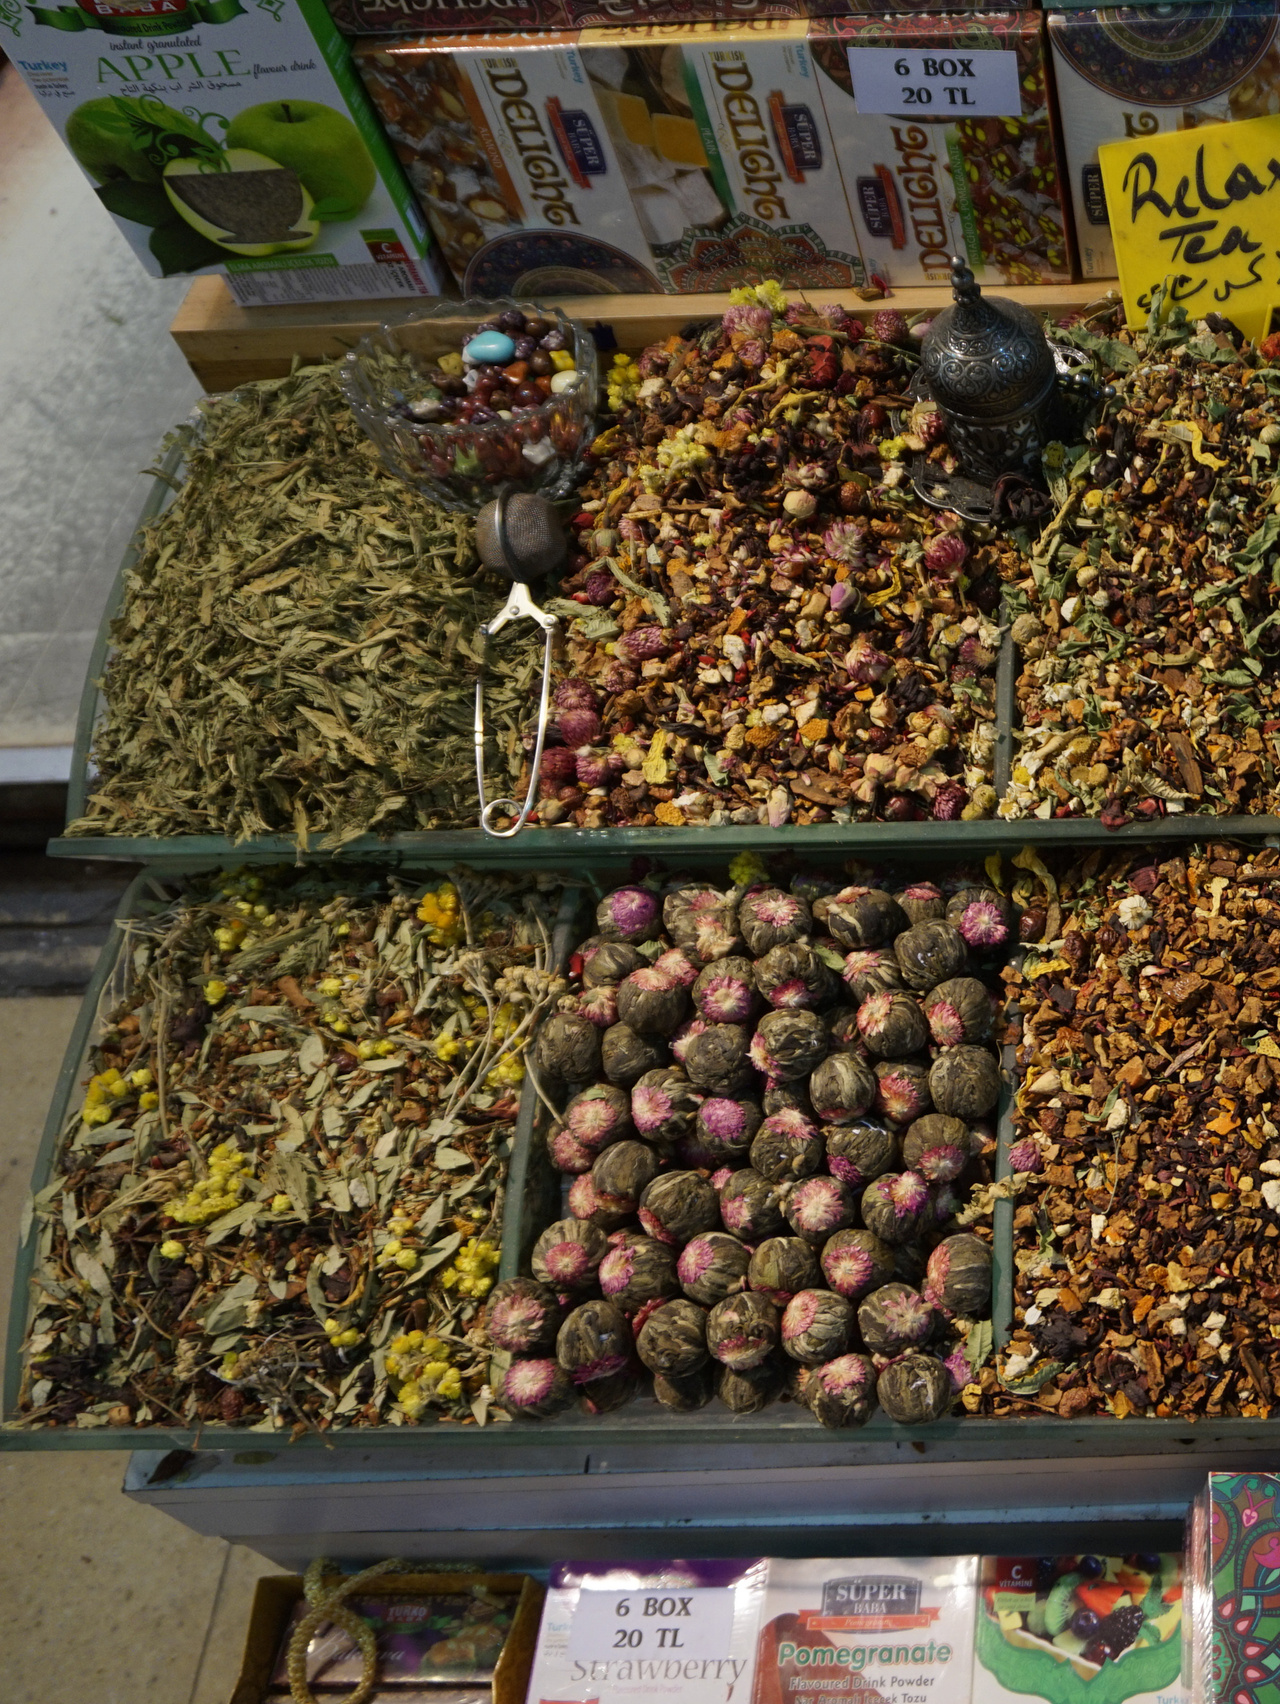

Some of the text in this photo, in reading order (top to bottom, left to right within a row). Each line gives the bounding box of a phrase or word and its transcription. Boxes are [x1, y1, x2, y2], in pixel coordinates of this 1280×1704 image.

[17, 60, 68, 73] Turkey
[96, 49, 251, 84] APPLE
[894, 57, 976, 77] 6 BOX
[902, 86, 976, 105] 20 TL
[479, 126, 504, 169] ALMOND
[572, 118, 600, 166] SÜPER
[701, 127, 718, 156] PLAIN
[794, 113, 817, 160] SÜPER
[950, 144, 971, 213] POMEGRANATE
[862, 185, 883, 229] SÜPER
[381, 242, 393, 253] C
[1158, 219, 1263, 265] Tea
[1011, 1564, 1022, 1580] C
[835, 1579, 908, 1602] SÜPER
[998, 1579, 1033, 1588] VİTAMİNİ
[615, 1597, 694, 1617] 6 BOX
[853, 1602, 888, 1615] BABA
[612, 1627, 685, 1649] 20 TL
[777, 1640, 953, 1672] Pomegranate
[570, 1659, 749, 1686] Strawberry
[789, 1674, 936, 1691] Flavoured Drink Powder
[901, 1693, 927, 1704] Tozu
